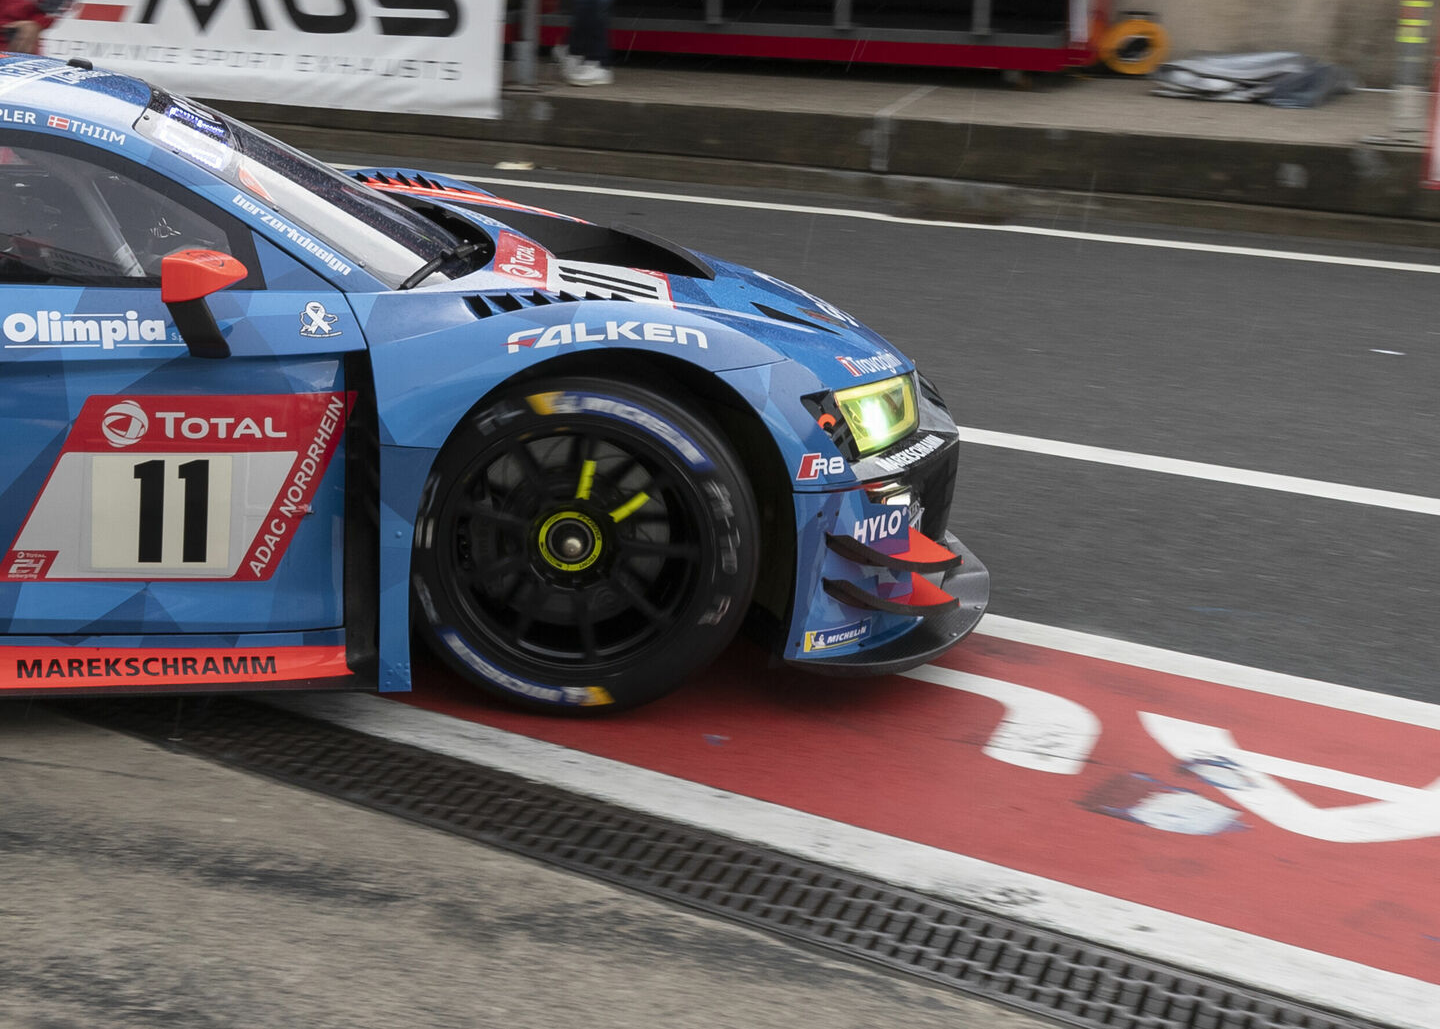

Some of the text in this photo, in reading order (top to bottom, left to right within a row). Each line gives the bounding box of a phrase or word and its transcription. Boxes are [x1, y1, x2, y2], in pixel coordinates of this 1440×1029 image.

[70, 119, 127, 146] THIIM
[3, 310, 167, 349] Olimpia
[501, 320, 709, 354] FALKEN
[155, 411, 288, 440] TOTAL
[809, 455, 845, 477] R8
[248, 518, 288, 578] ADAC
[279, 395, 345, 516] NORDRHEIN
[133, 459, 210, 564] 11
[853, 510, 902, 544] HYLO
[826, 625, 868, 645] MICHELIN
[16, 656, 277, 679] MAREKSCHRAMM
